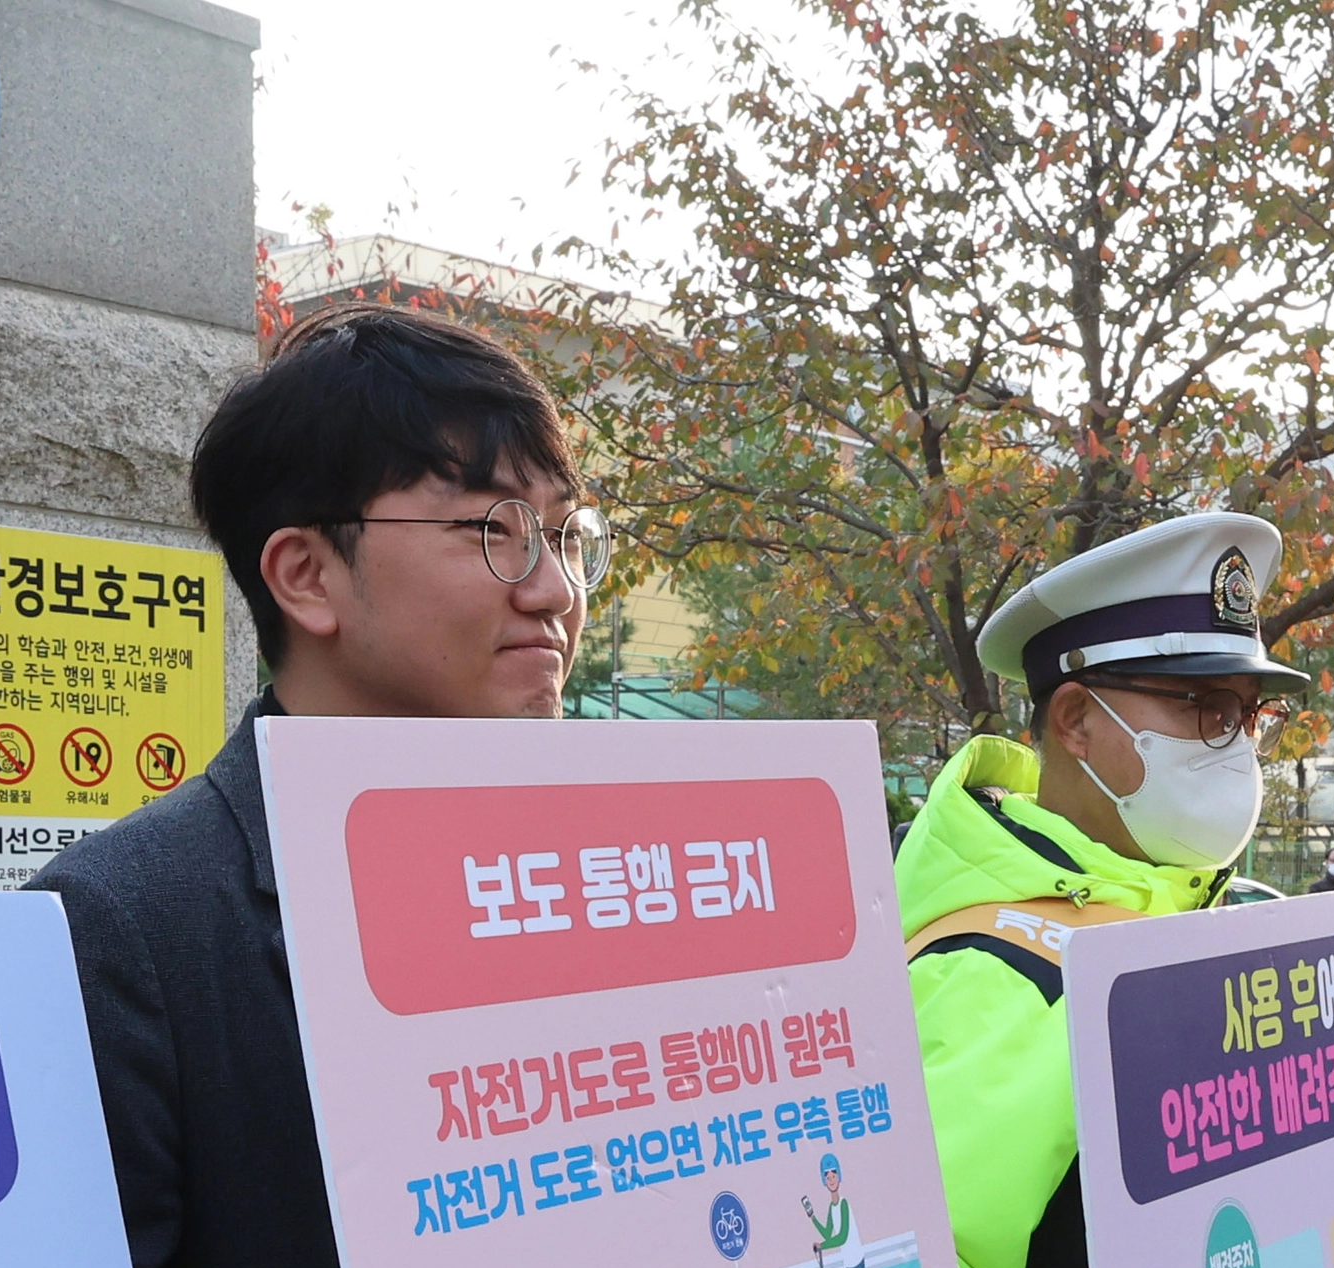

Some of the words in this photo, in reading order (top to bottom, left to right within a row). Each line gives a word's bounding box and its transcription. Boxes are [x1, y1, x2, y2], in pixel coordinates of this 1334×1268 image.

[18, 634, 67, 660] 학습과
[23, 662, 56, 687] 주는
[64, 666, 94, 689] 행위
[102, 668, 116, 690] 및
[124, 670, 168, 694] 시설을
[50, 691, 130, 717] 지역입니다.
[0, 731, 14, 739] GAS
[66, 791, 109, 806] 유해시설
[463, 851, 572, 938] 보도
[579, 842, 677, 928] 통행
[684, 837, 776, 919] 금지
[1222, 966, 1284, 1054] 사용
[428, 1039, 655, 1142] 자전거도로
[661, 1019, 778, 1094] 통행이
[782, 1007, 856, 1079] 원칙
[1161, 1065, 1264, 1174] 안전한
[406, 1157, 526, 1236] 자전거
[531, 1145, 609, 1208] 도로
[606, 1120, 705, 1193] 없으면
[707, 1108, 770, 1164] 차도
[777, 1096, 833, 1153] 우측
[837, 1082, 893, 1141] 통행
